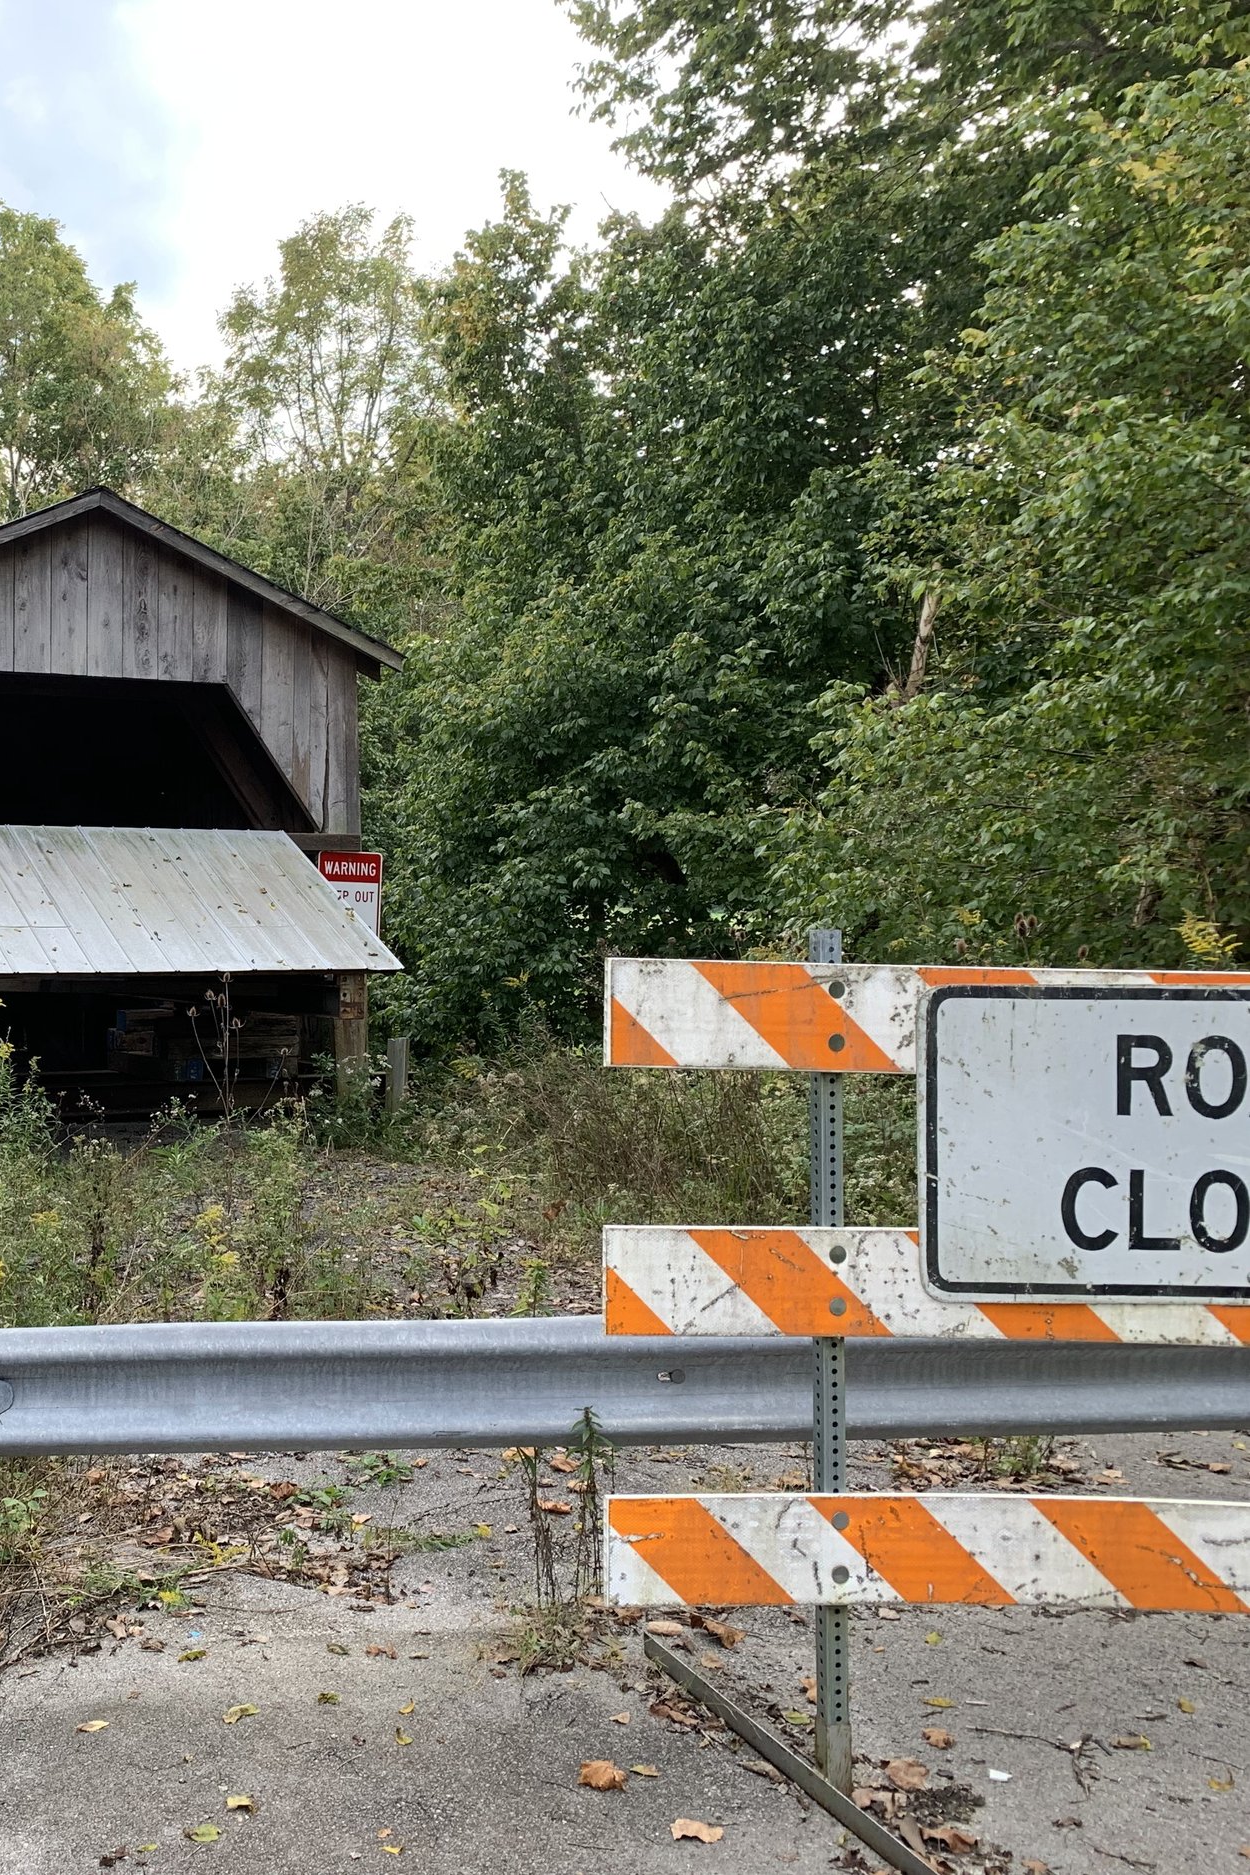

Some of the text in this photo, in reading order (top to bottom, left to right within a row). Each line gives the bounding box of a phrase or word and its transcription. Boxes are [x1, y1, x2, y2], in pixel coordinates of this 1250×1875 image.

[324, 861, 376, 877] WARNING
[355, 890, 374, 903] OUT
[1060, 1166, 1250, 1254] CLO
